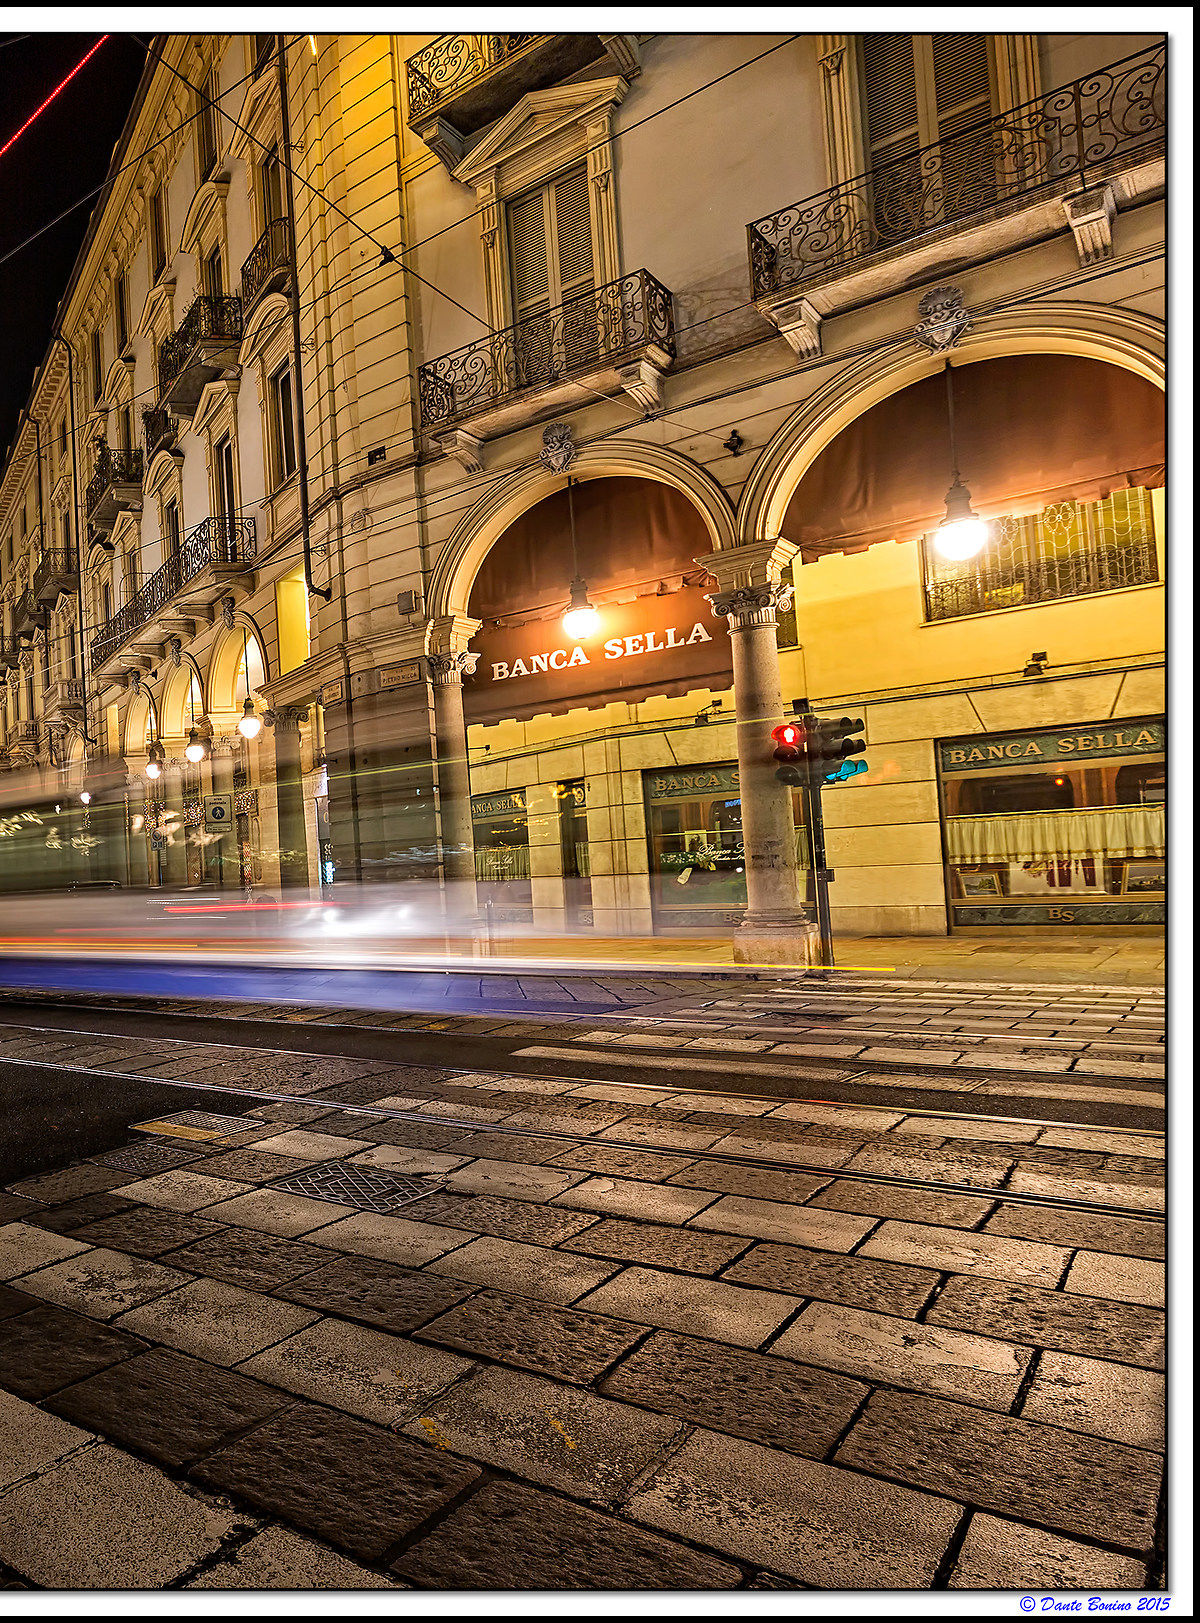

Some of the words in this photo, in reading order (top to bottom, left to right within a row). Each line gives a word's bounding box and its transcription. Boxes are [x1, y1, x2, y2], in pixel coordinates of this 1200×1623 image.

[491, 646, 590, 681] BANCA
[604, 622, 712, 660] SELLA
[949, 741, 1044, 765] BANCA
[1058, 730, 1158, 753] SELLA
[655, 774, 722, 792] BANCA
[472, 802, 493, 814] ANCA
[1048, 908, 1075, 922] BS
